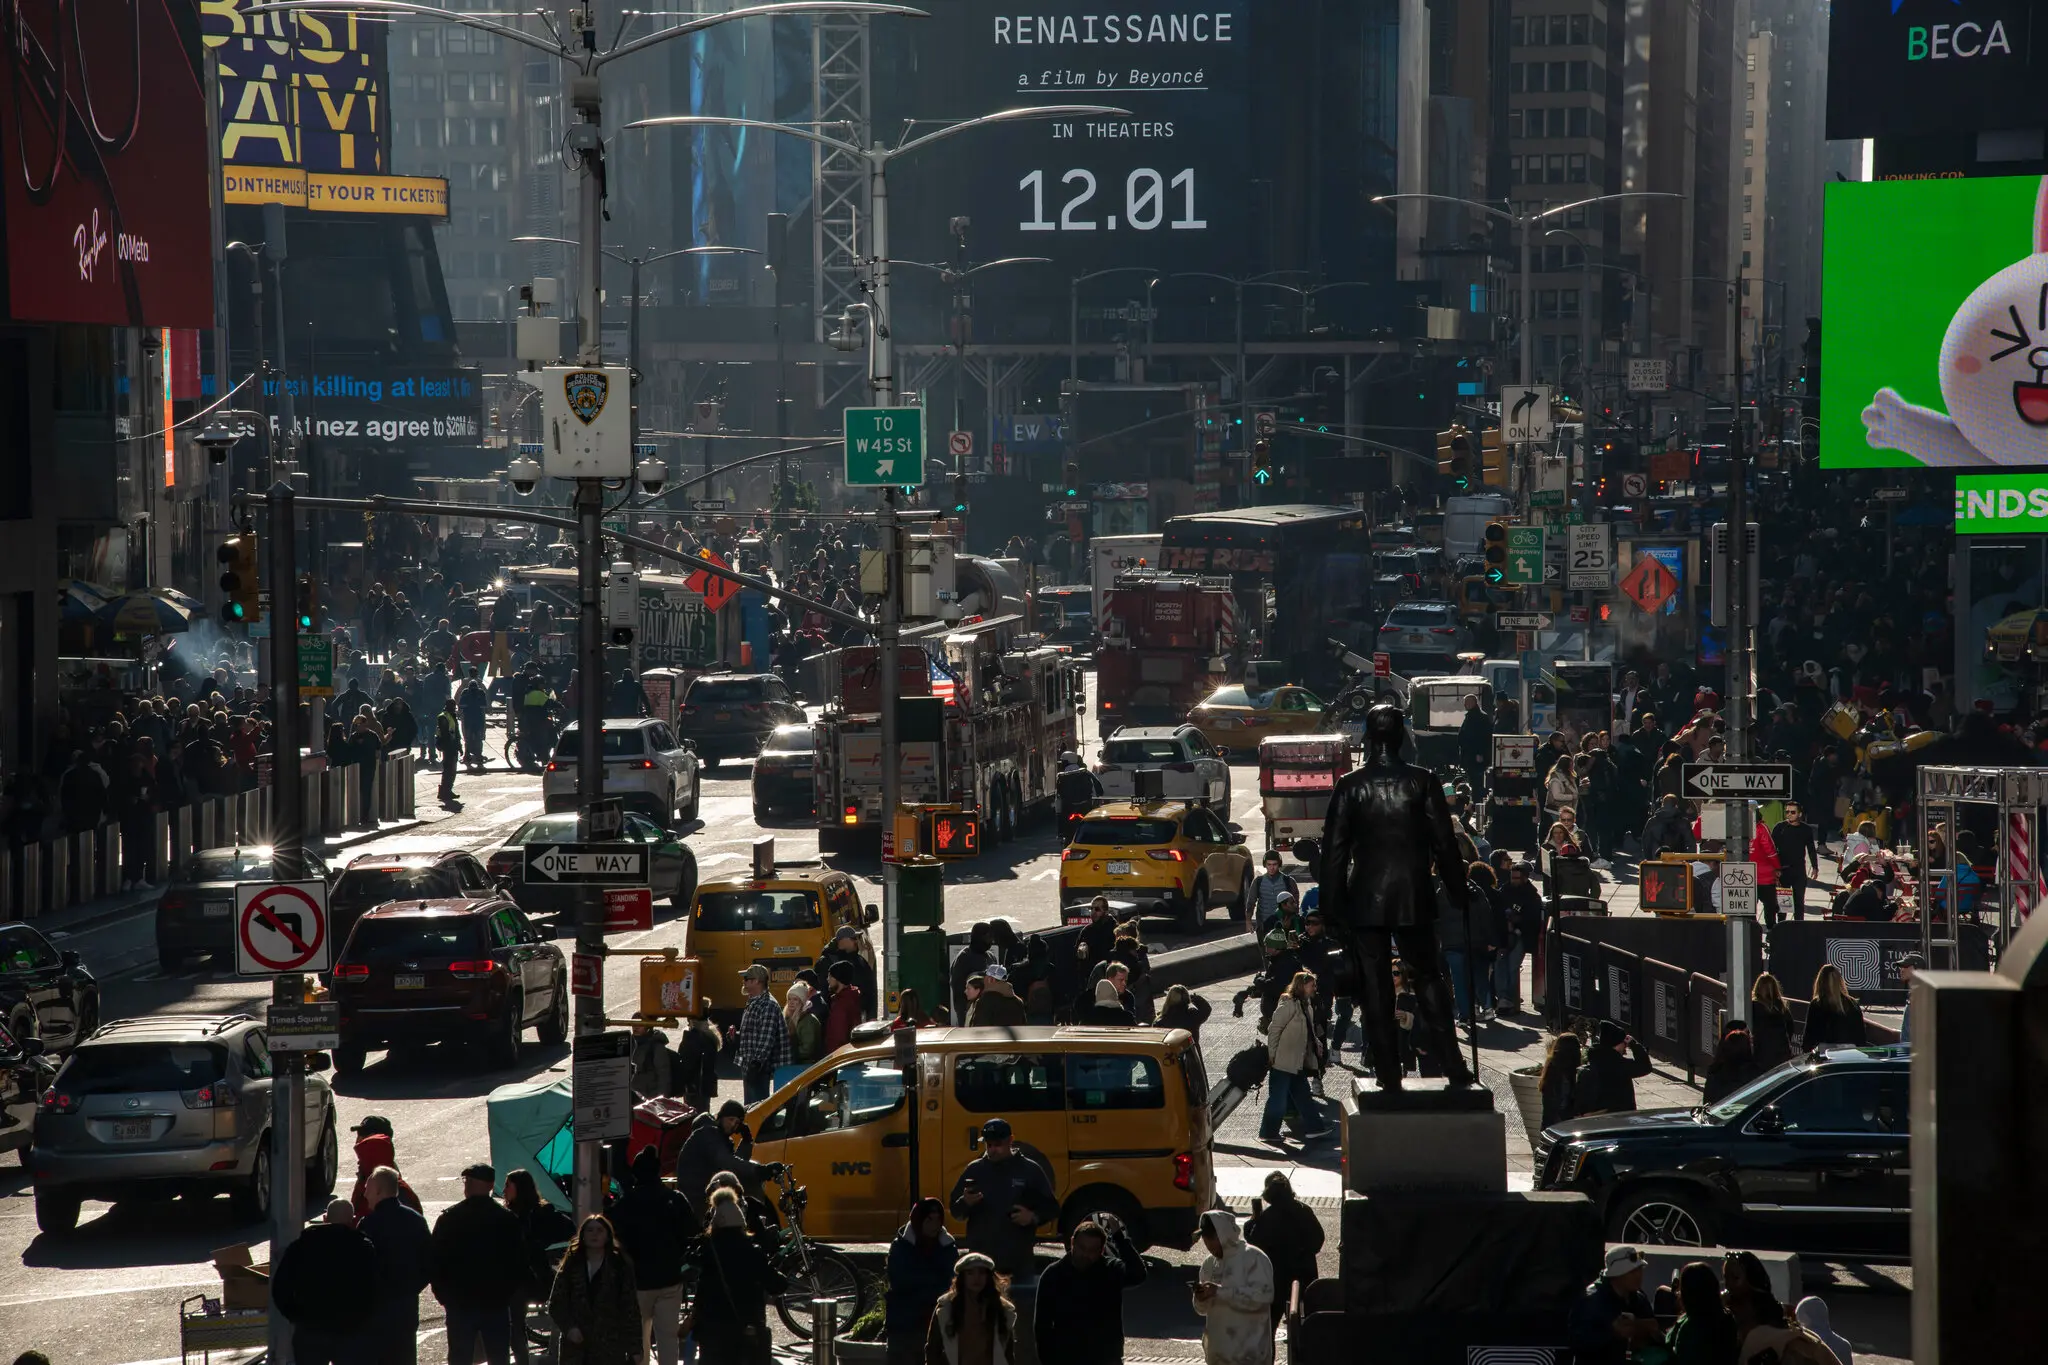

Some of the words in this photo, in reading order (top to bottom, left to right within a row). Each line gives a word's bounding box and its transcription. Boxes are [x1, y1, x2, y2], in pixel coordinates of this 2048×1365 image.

[994, 13, 1232, 44] RENAISSANCE
[1907, 20, 2012, 61] BECA
[1018, 73, 1029, 86] a
[1039, 70, 1086, 85] film
[1096, 68, 1119, 88] by
[1128, 68, 1204, 87] Beyoncé
[1052, 123, 1073, 139] IN
[1086, 122, 1174, 138] THEATERS
[328, 185, 375, 201] YOUR
[382, 187, 435, 204] TICKETS
[1019, 168, 1207, 231] 12.01
[128, 234, 149, 262] Meta
[312, 375, 384, 401] killing
[391, 376, 416, 397] at
[420, 377, 451, 397] least
[366, 421, 430, 442] agree
[433, 417, 444, 437] to
[873, 416, 894, 433] TO
[1509, 427, 1542, 438] ONLY
[520, 445, 543, 454] NYPD
[856, 438, 869, 453] W
[871, 438, 893, 453] 45
[896, 438, 913, 453] St
[1576, 533, 1601, 541] SPEED
[1508, 547, 1541, 556] Broadway
[1574, 550, 1605, 568] 25
[639, 596, 706, 613] SCOVER
[1505, 617, 1521, 625] ONE
[303, 663, 326, 672] South
[1700, 775, 1729, 787] ONE
[1744, 775, 1777, 788] WAY
[965, 822, 976, 848] 2
[543, 855, 578, 871] ONE
[595, 856, 633, 872] WAY
[610, 893, 639, 903] STANDING
[1727, 888, 1750, 897] WALK
[1729, 900, 1749, 910] BIKE
[1887, 950, 1921, 960] TIM
[270, 1016, 296, 1024] Times
[297, 1015, 329, 1025] Square
[832, 1162, 871, 1175] NYC
